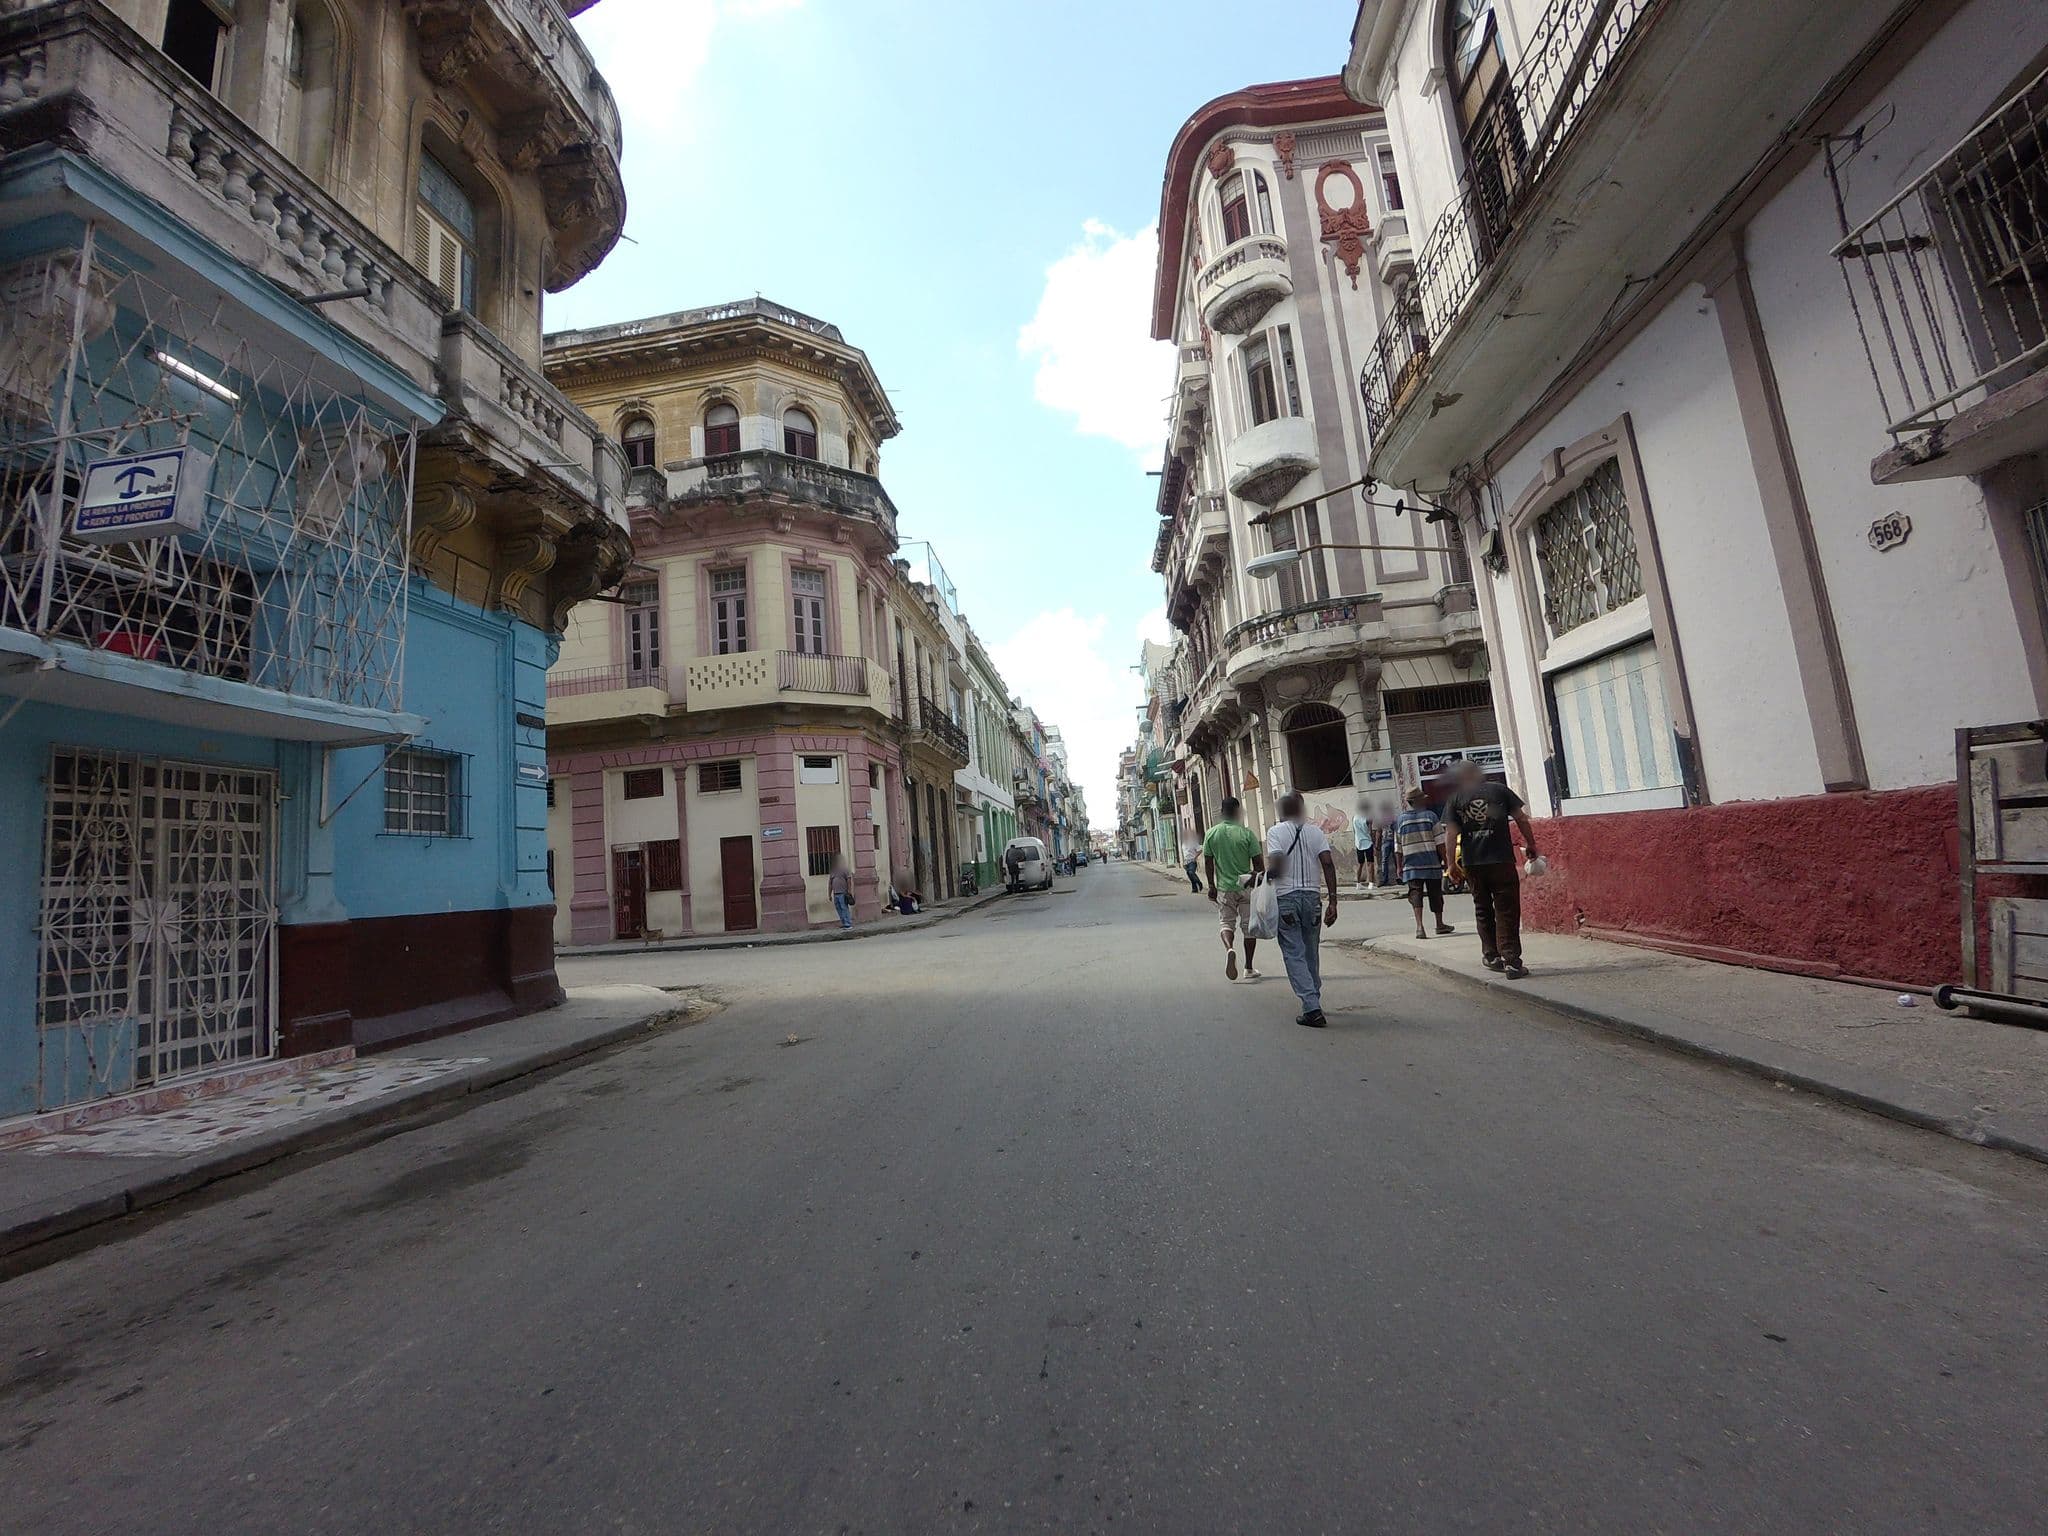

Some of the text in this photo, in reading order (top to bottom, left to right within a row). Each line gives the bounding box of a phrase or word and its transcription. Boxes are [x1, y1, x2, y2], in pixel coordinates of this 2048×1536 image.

[89, 506, 117, 515] RENTA
[118, 503, 129, 512] LA
[131, 499, 172, 510] PROPIEDAD
[89, 509, 165, 525] RENT OF PROPERTY
[1874, 519, 1902, 545] 568
